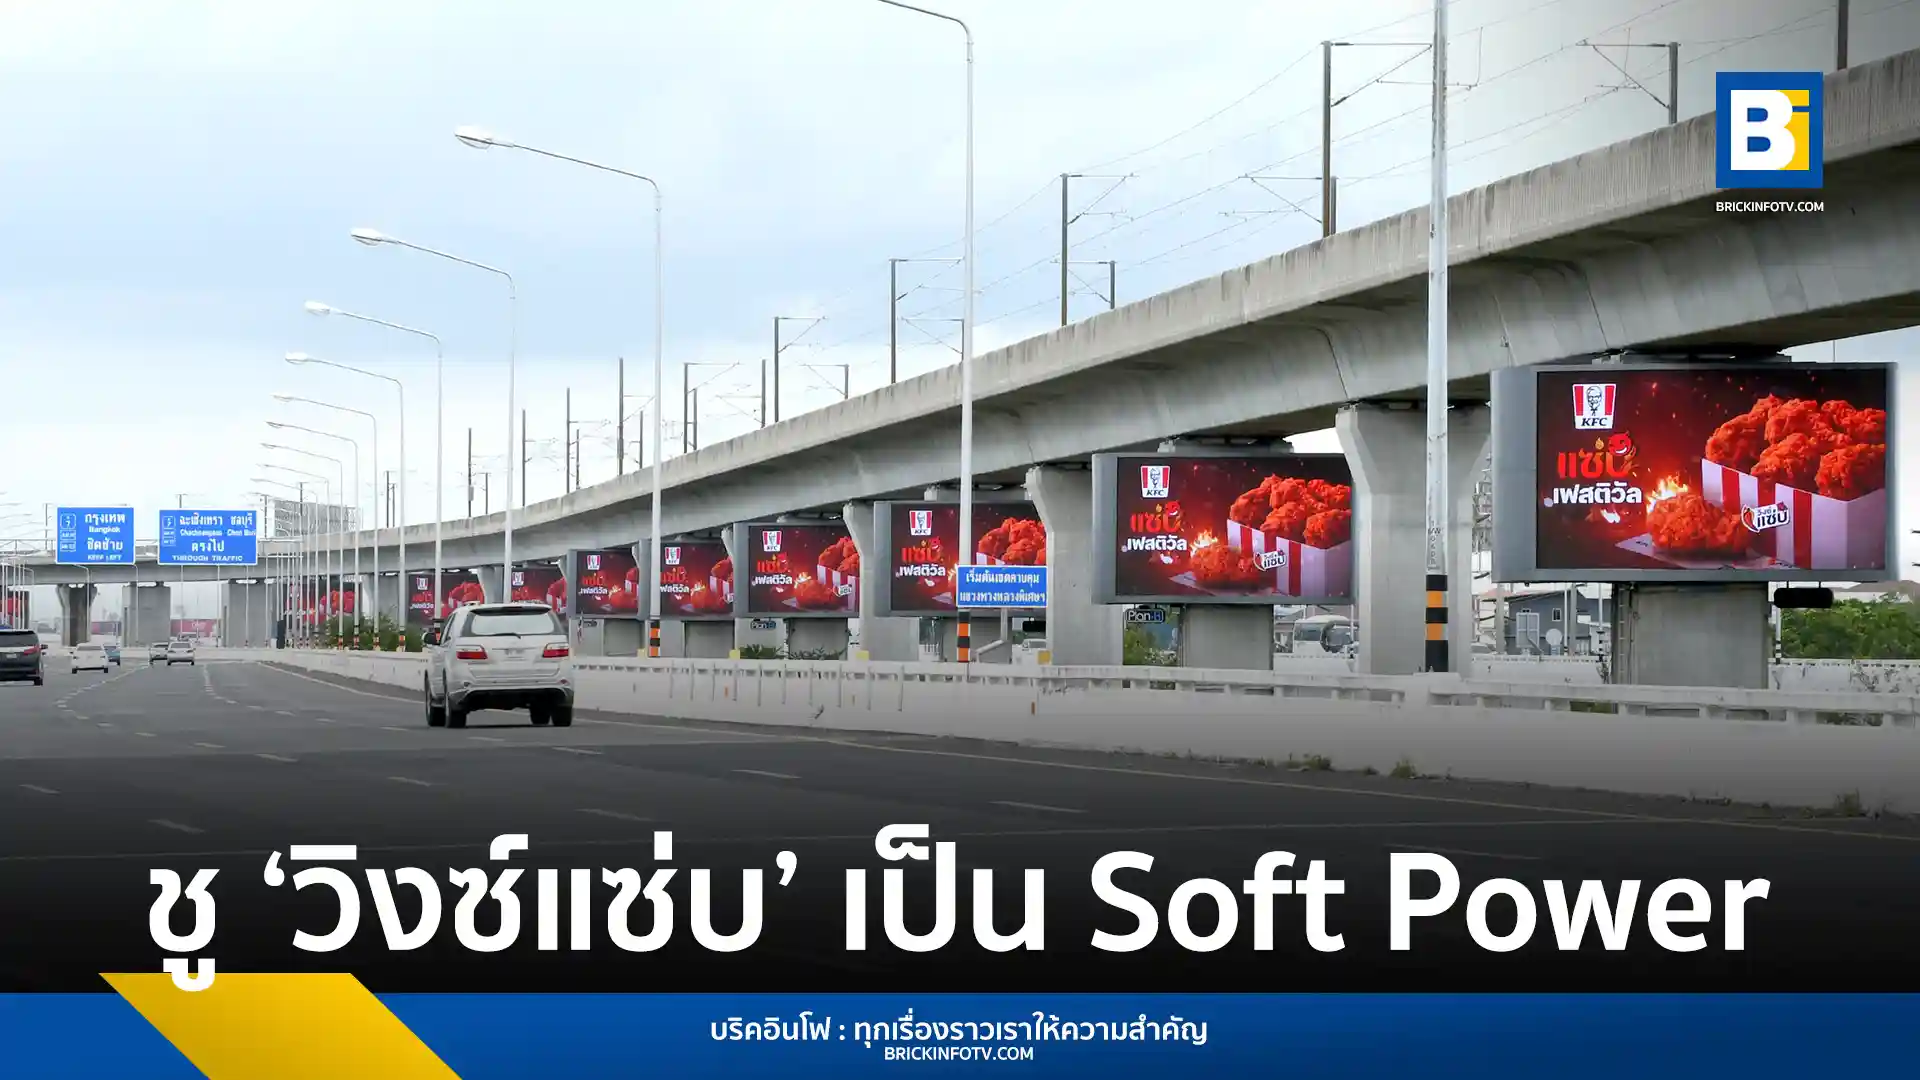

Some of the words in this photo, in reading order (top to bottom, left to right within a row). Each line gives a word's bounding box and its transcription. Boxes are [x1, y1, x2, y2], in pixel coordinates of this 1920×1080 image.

[1581, 417, 1608, 427] KFC
[1553, 481, 1642, 504] เฟสติวัล
[84, 513, 126, 526] กรุงเทพ
[1127, 534, 1188, 551] เฟสติวัล
